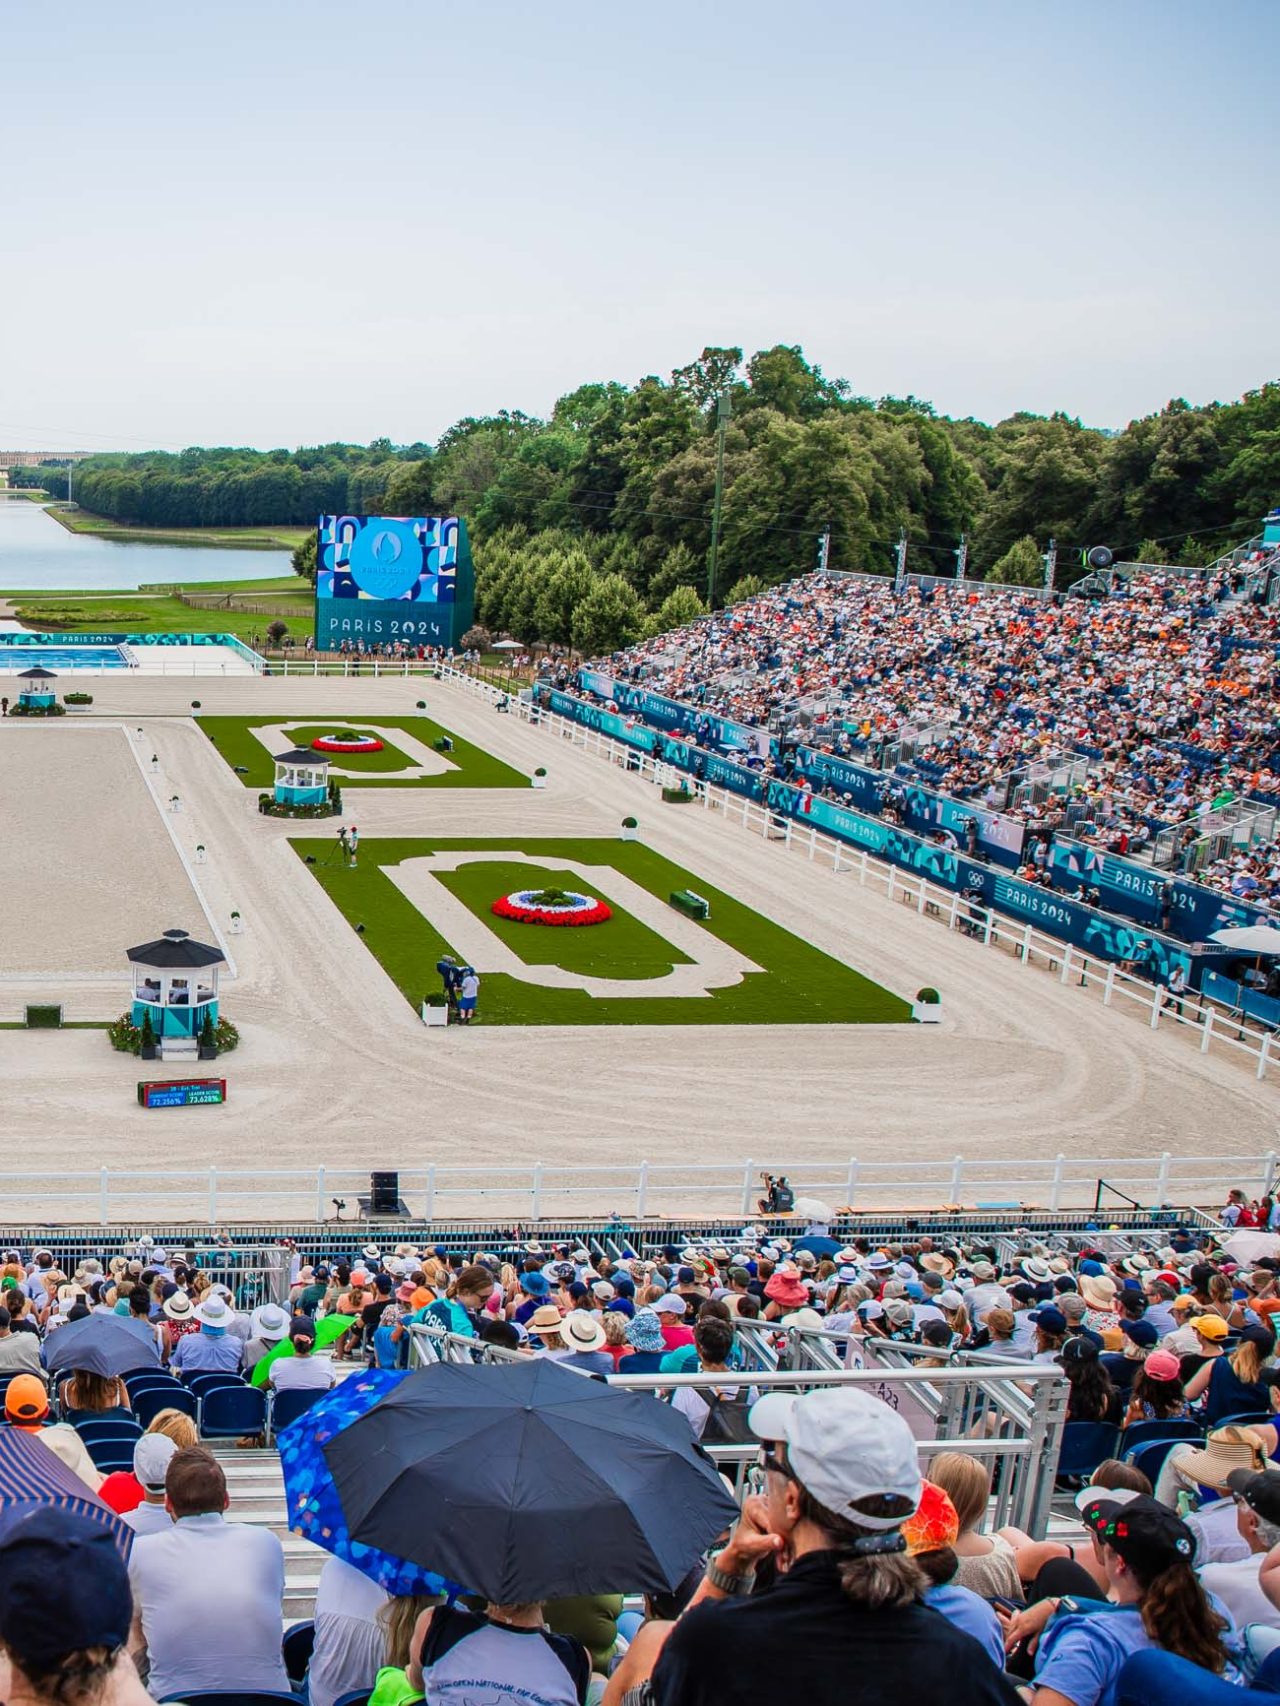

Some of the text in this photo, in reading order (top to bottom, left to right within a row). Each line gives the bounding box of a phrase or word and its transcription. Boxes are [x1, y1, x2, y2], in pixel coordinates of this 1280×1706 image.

[330, 617, 440, 636] PARIS 2024
[62, 635, 114, 643] PARIS 2024
[730, 771, 746, 785] 2024
[845, 771, 866, 789] 2024
[835, 814, 880, 842] PARIS 2024
[1114, 870, 1154, 897] PARIS
[1006, 888, 1072, 926] PARIS 2024
[453, 1678, 475, 1688] OPEN
[475, 1678, 514, 1693] NATIONAL
